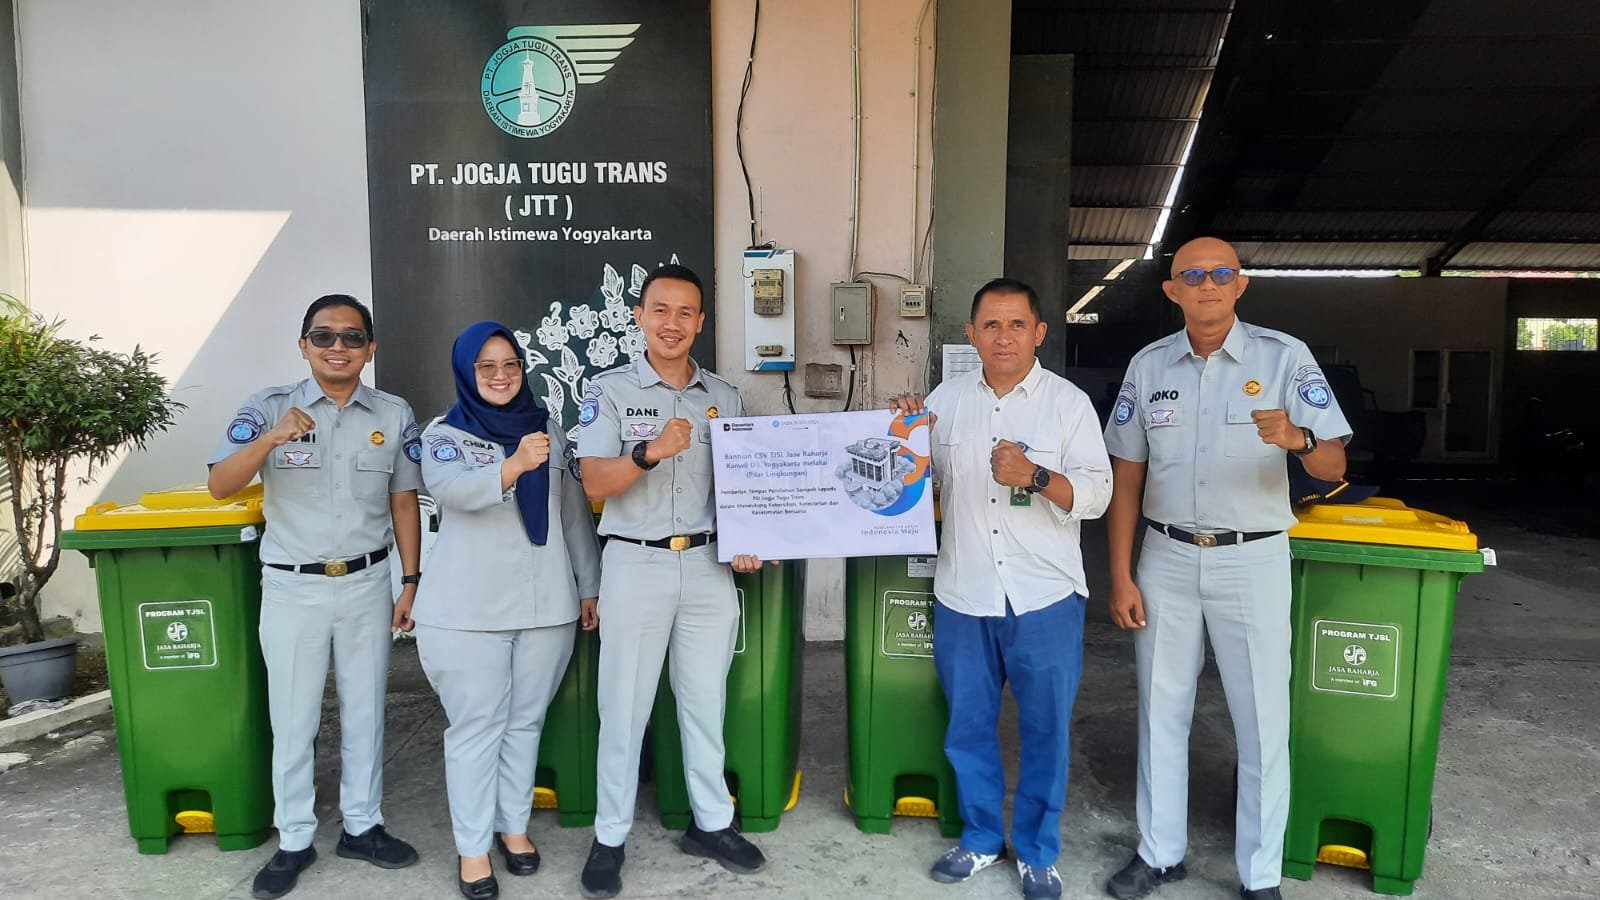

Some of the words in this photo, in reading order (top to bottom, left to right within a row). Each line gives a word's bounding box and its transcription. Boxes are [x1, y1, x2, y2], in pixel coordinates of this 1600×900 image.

[494, 41, 520, 65] JOGJA
[523, 40, 549, 51] TUGU
[550, 49, 572, 79] TRANS
[483, 90, 502, 122] DAERAH
[501, 119, 539, 137] ISTIMEWA
[539, 89, 575, 135] YOGYAKARTA
[410, 163, 444, 185] PT.
[452, 163, 522, 185] JOGJA
[527, 162, 587, 184] TUGU
[594, 161, 668, 184] TRANS
[428, 226, 485, 242] Daerah
[488, 226, 559, 242] Istimewa
[562, 226, 653, 244] Yogyakarta
[1149, 390, 1179, 403] JOKO
[626, 407, 660, 417] DANE
[462, 439, 495, 451] CHIKA
[889, 598, 927, 607] PROGRAM
[145, 609, 185, 618] PROGRAM
[185, 608, 207, 616] TJSL
[895, 631, 910, 639] JASA
[1322, 629, 1367, 640] PROGRAM
[1368, 633, 1391, 642] TJSL
[156, 644, 172, 652] JASA
[1328, 665, 1346, 673] JASA
[1347, 667, 1380, 677] RAHARJA
